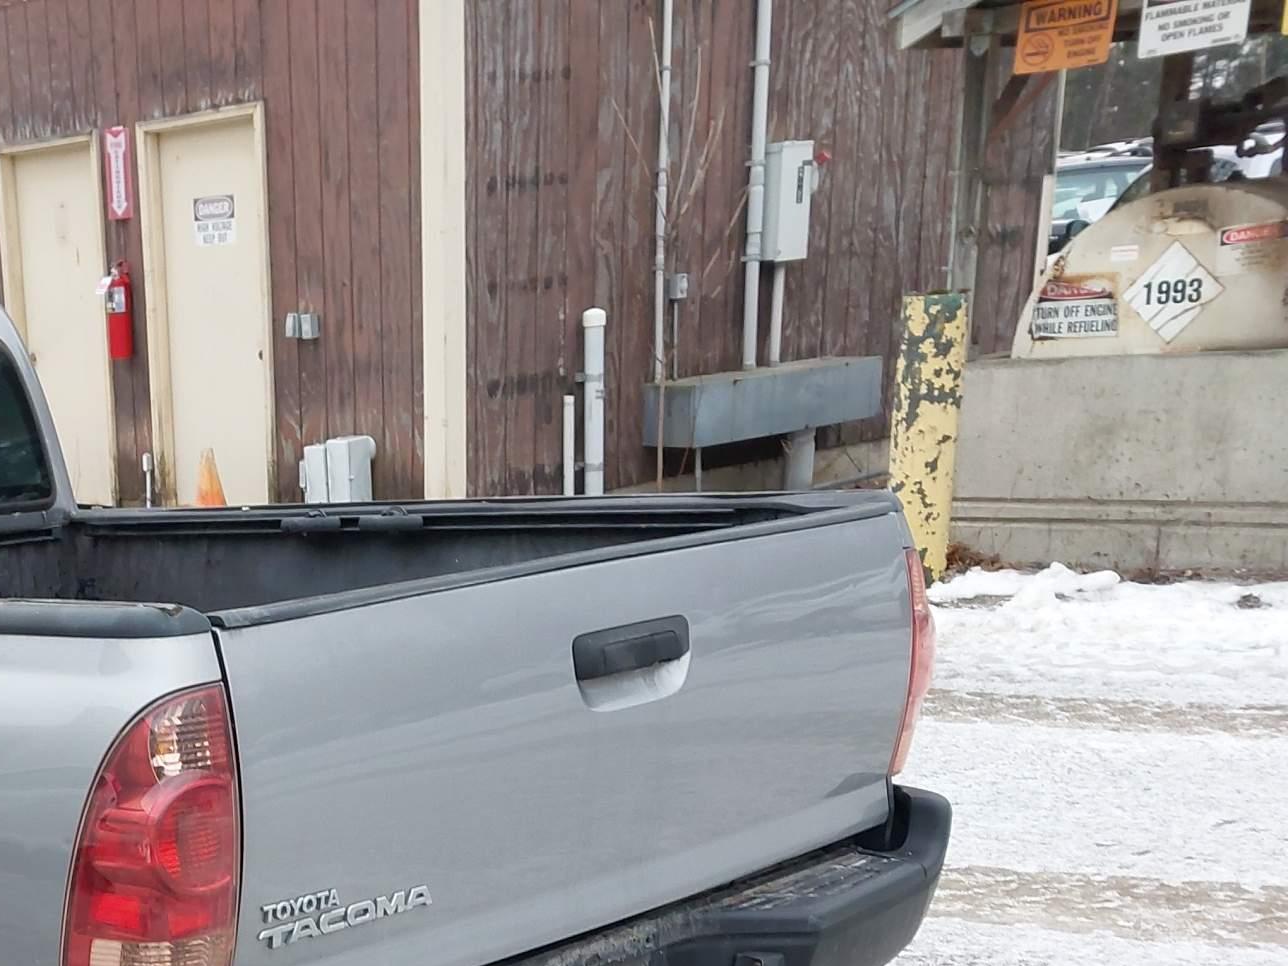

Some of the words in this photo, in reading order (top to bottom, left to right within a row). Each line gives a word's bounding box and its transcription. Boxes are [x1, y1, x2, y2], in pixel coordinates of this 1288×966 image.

[1036, 1, 1103, 25] WARNING
[1145, 3, 1199, 20] FLAMMABLE
[1158, 22, 1170, 31] NO
[1173, 14, 1214, 29] SMOKING
[1217, 11, 1231, 22] OR
[1161, 31, 1184, 42] OPEN
[1187, 23, 1223, 37] FLAMES
[1144, 278, 1203, 305] 1993
[1036, 307, 1059, 319] TURN
[1064, 305, 1080, 318] OFF
[1084, 303, 1118, 317] ENGINE
[1035, 321, 1063, 334] WHILE
[261, 889, 341, 923] TOYOTA
[257, 885, 433, 949] TACOMA
